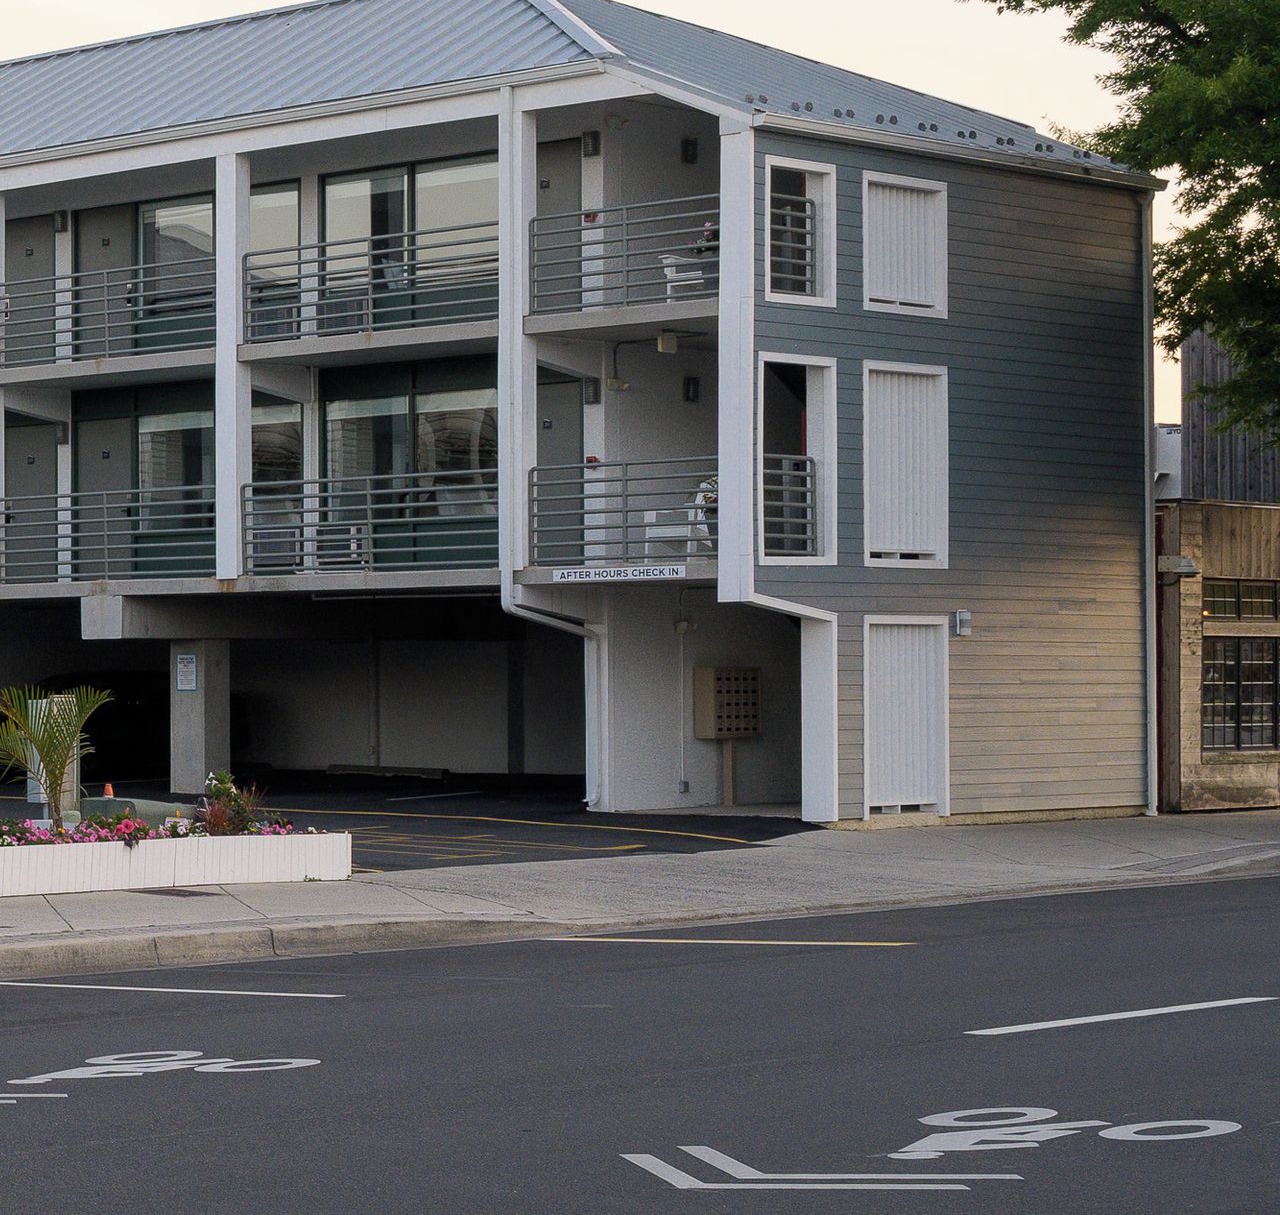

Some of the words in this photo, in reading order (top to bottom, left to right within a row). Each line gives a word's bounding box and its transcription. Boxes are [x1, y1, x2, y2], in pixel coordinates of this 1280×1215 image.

[559, 570, 591, 580] AFTER
[593, 569, 629, 579] HOURS
[631, 568, 665, 578] CHECK
[668, 567, 680, 576] IN
